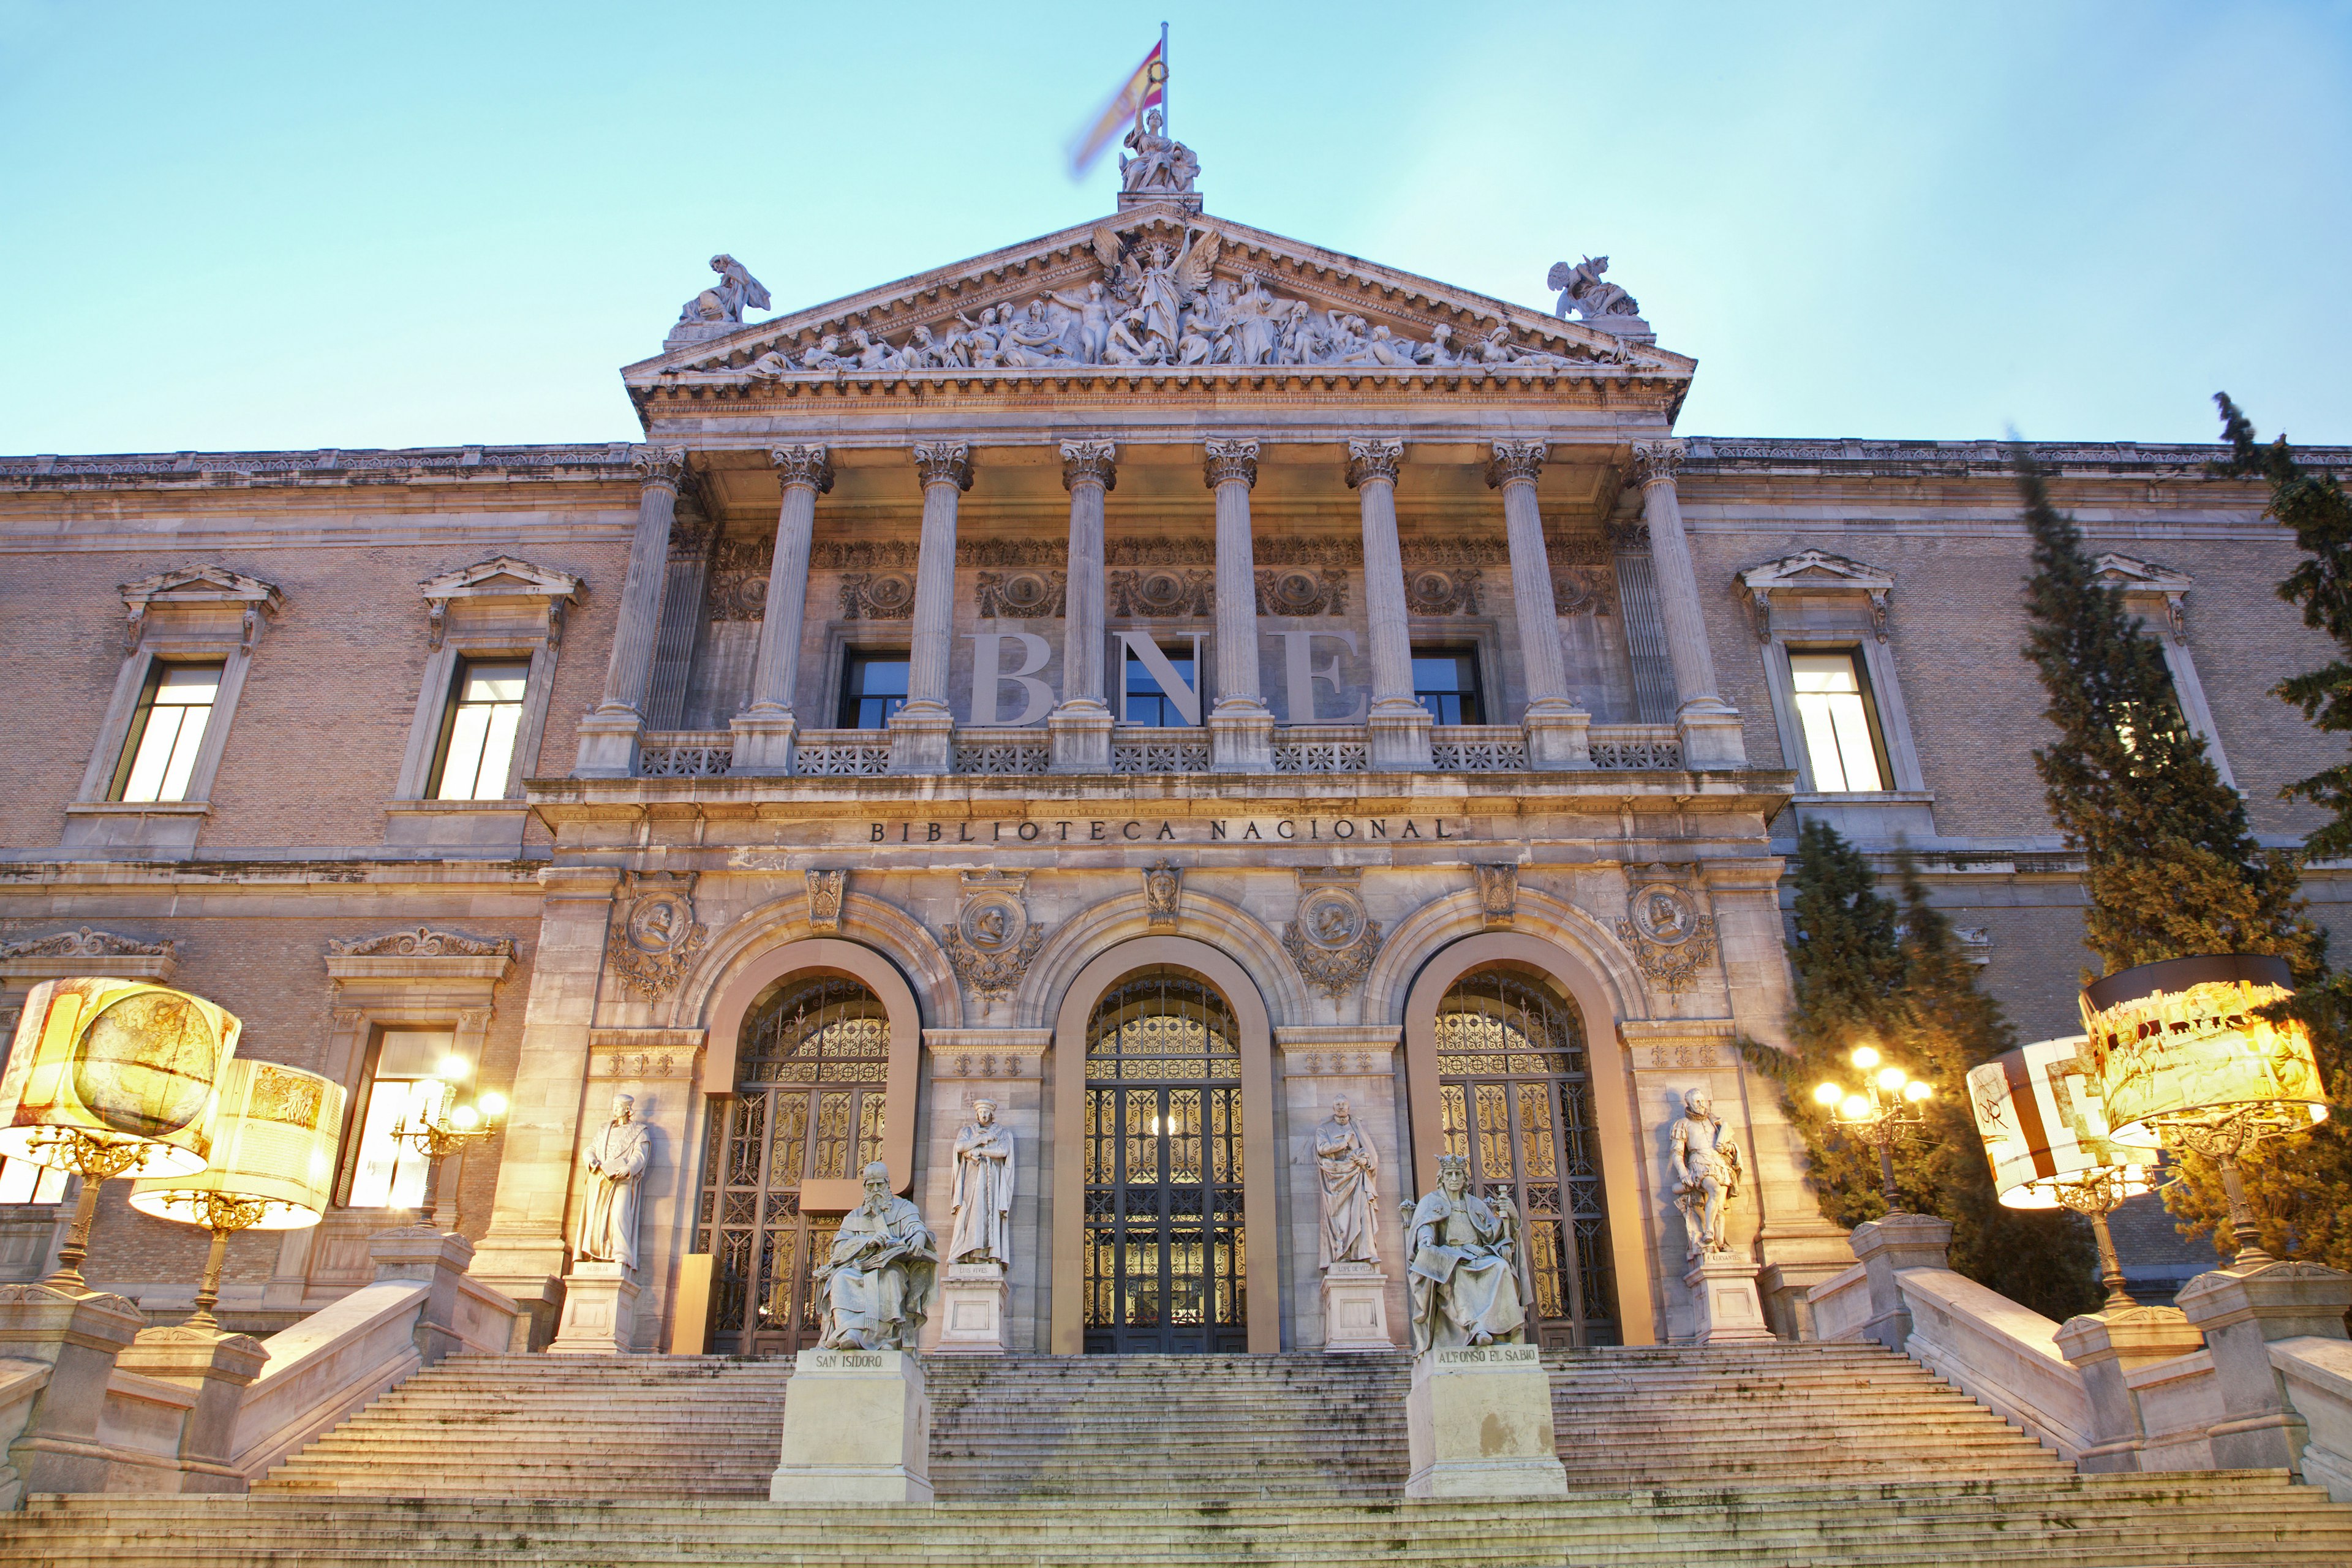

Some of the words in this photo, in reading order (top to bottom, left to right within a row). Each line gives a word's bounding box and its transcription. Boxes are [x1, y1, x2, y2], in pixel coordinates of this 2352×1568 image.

[870, 821, 1176, 842] BIBLIOTECA
[1211, 818, 1452, 840] NACIONAL
[816, 1355, 837, 1367] SAN
[1439, 1349, 1485, 1363] ALFONSO
[1490, 1349, 1502, 1362] EL
